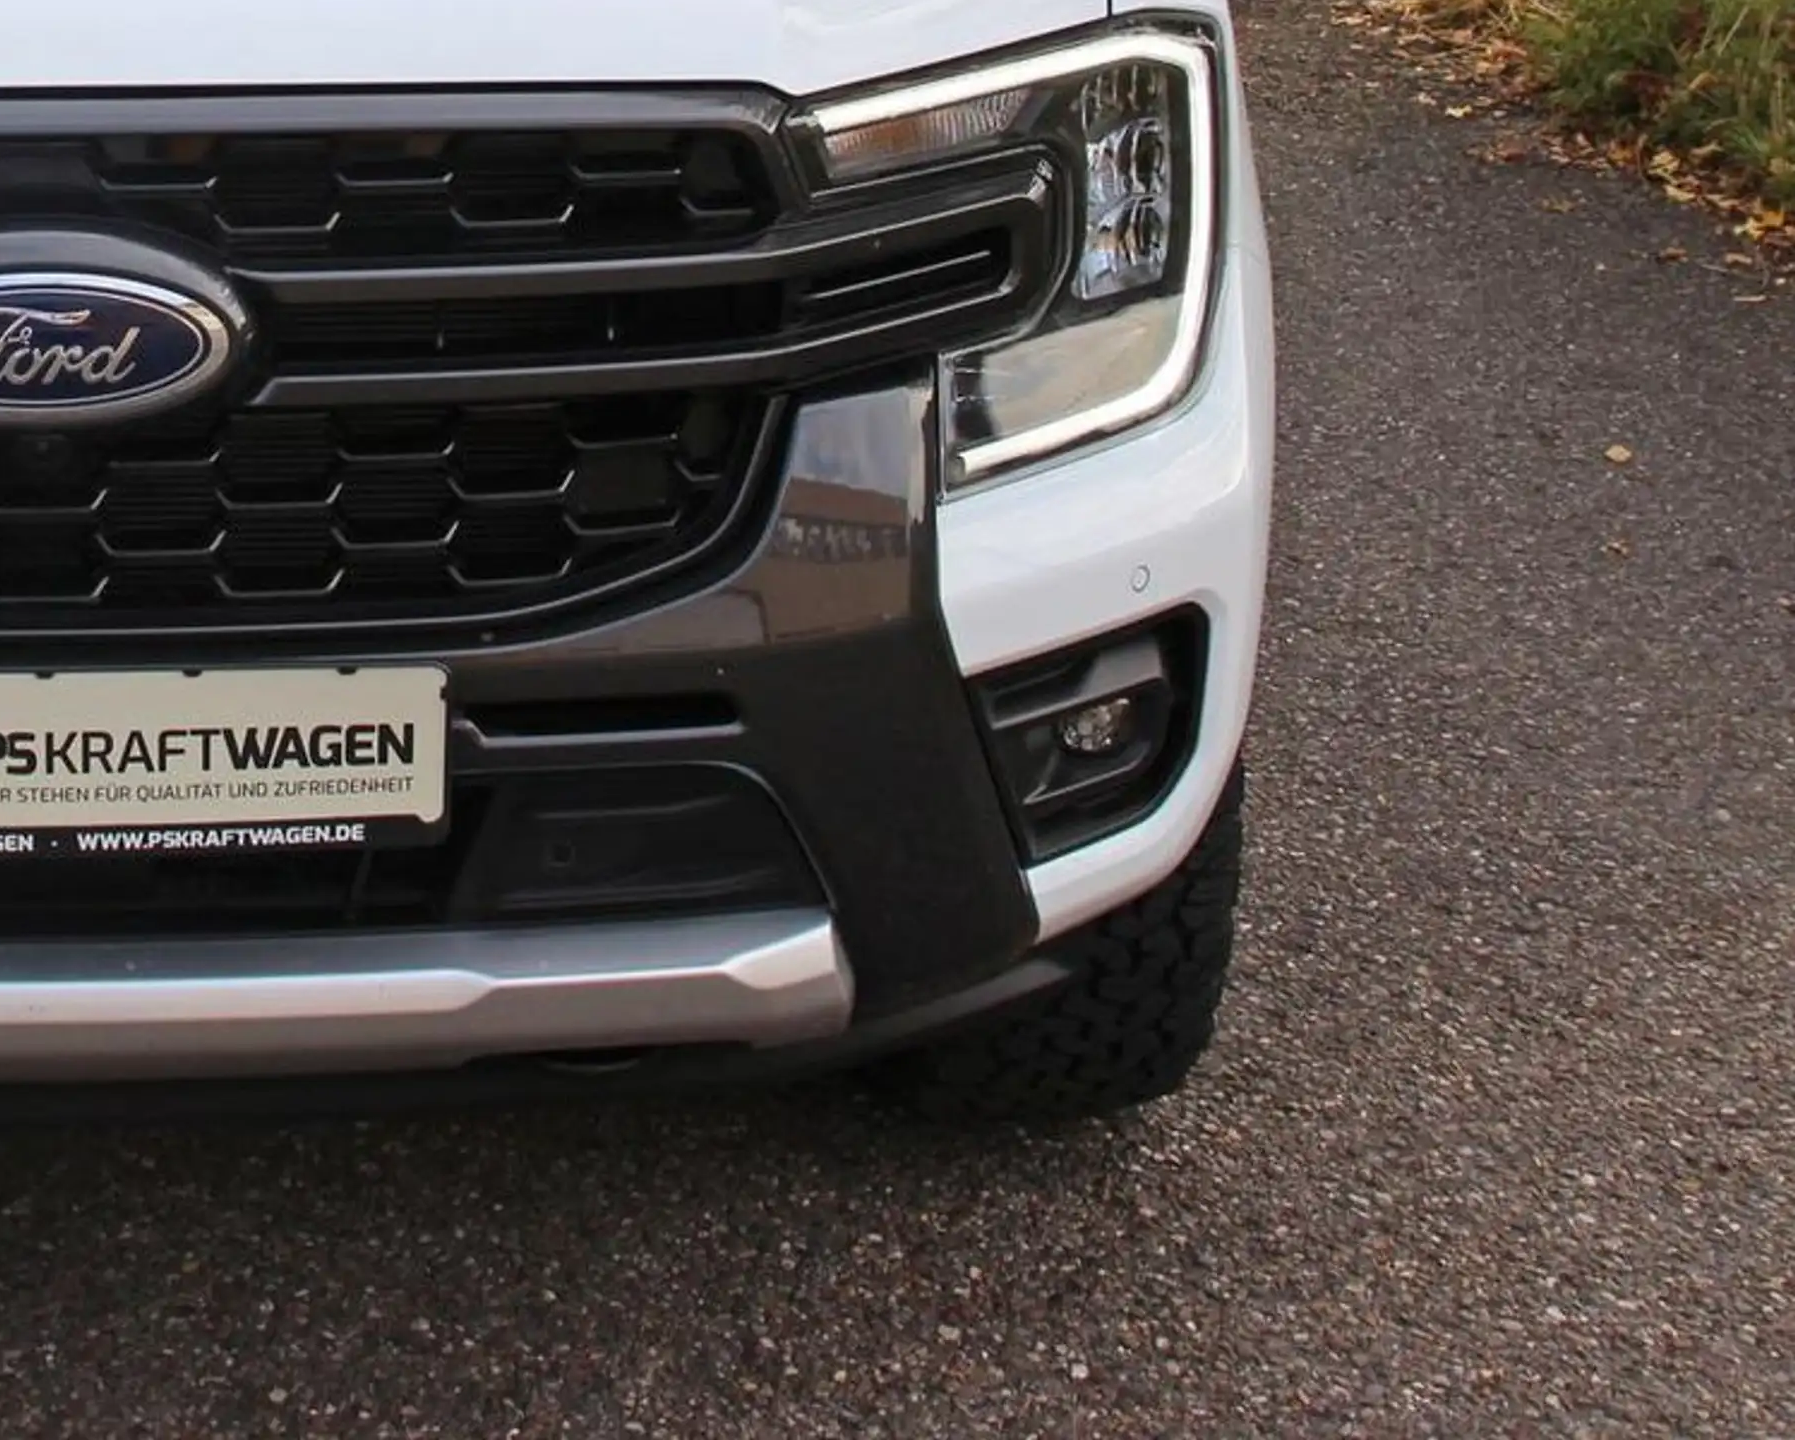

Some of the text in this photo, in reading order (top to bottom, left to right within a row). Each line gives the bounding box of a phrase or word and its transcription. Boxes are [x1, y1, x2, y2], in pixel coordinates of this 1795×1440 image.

[16, 785, 90, 804] STEHEN
[93, 781, 133, 803] FÜR
[227, 781, 269, 800] UND
[273, 775, 414, 798] ZUFRIEDENHEIT
[76, 822, 366, 852] WWW.PSKRAFTWAGEN.DE
